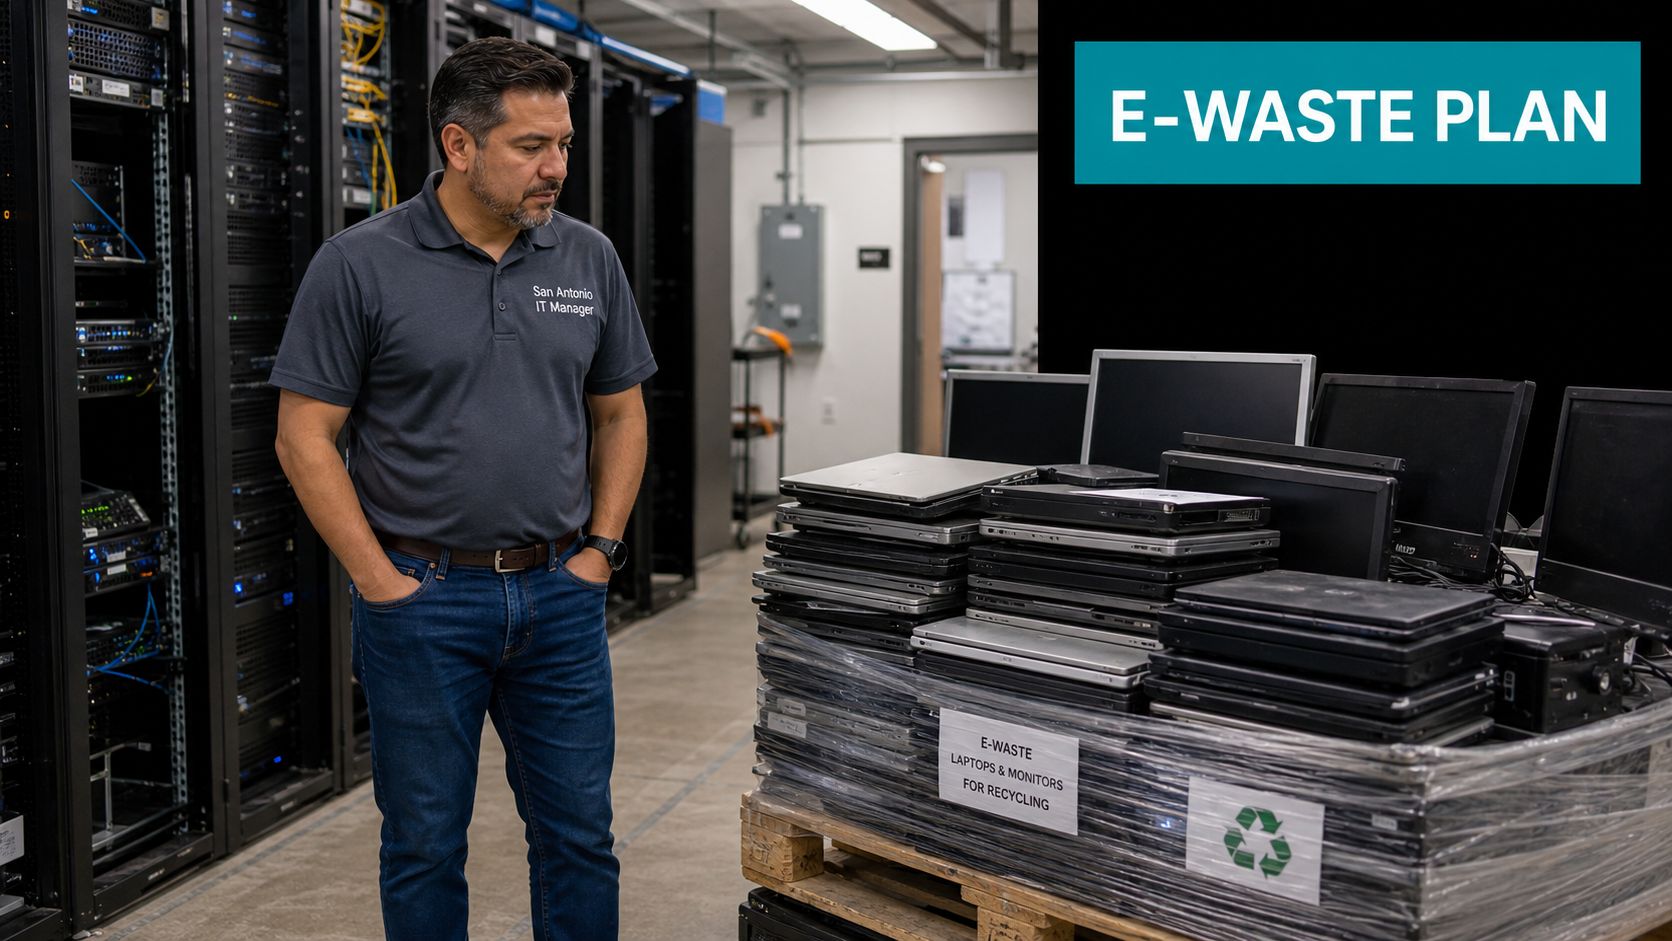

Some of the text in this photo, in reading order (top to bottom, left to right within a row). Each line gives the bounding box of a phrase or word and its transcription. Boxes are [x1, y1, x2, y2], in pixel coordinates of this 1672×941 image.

[532, 285, 593, 300] San Antonio
[535, 301, 594, 317] IT Manager
[981, 736, 1032, 760] E-WASTE
[951, 753, 1064, 791] LAPTOPS & MONITORS
[963, 778, 1050, 811] FOR RECYCLING
